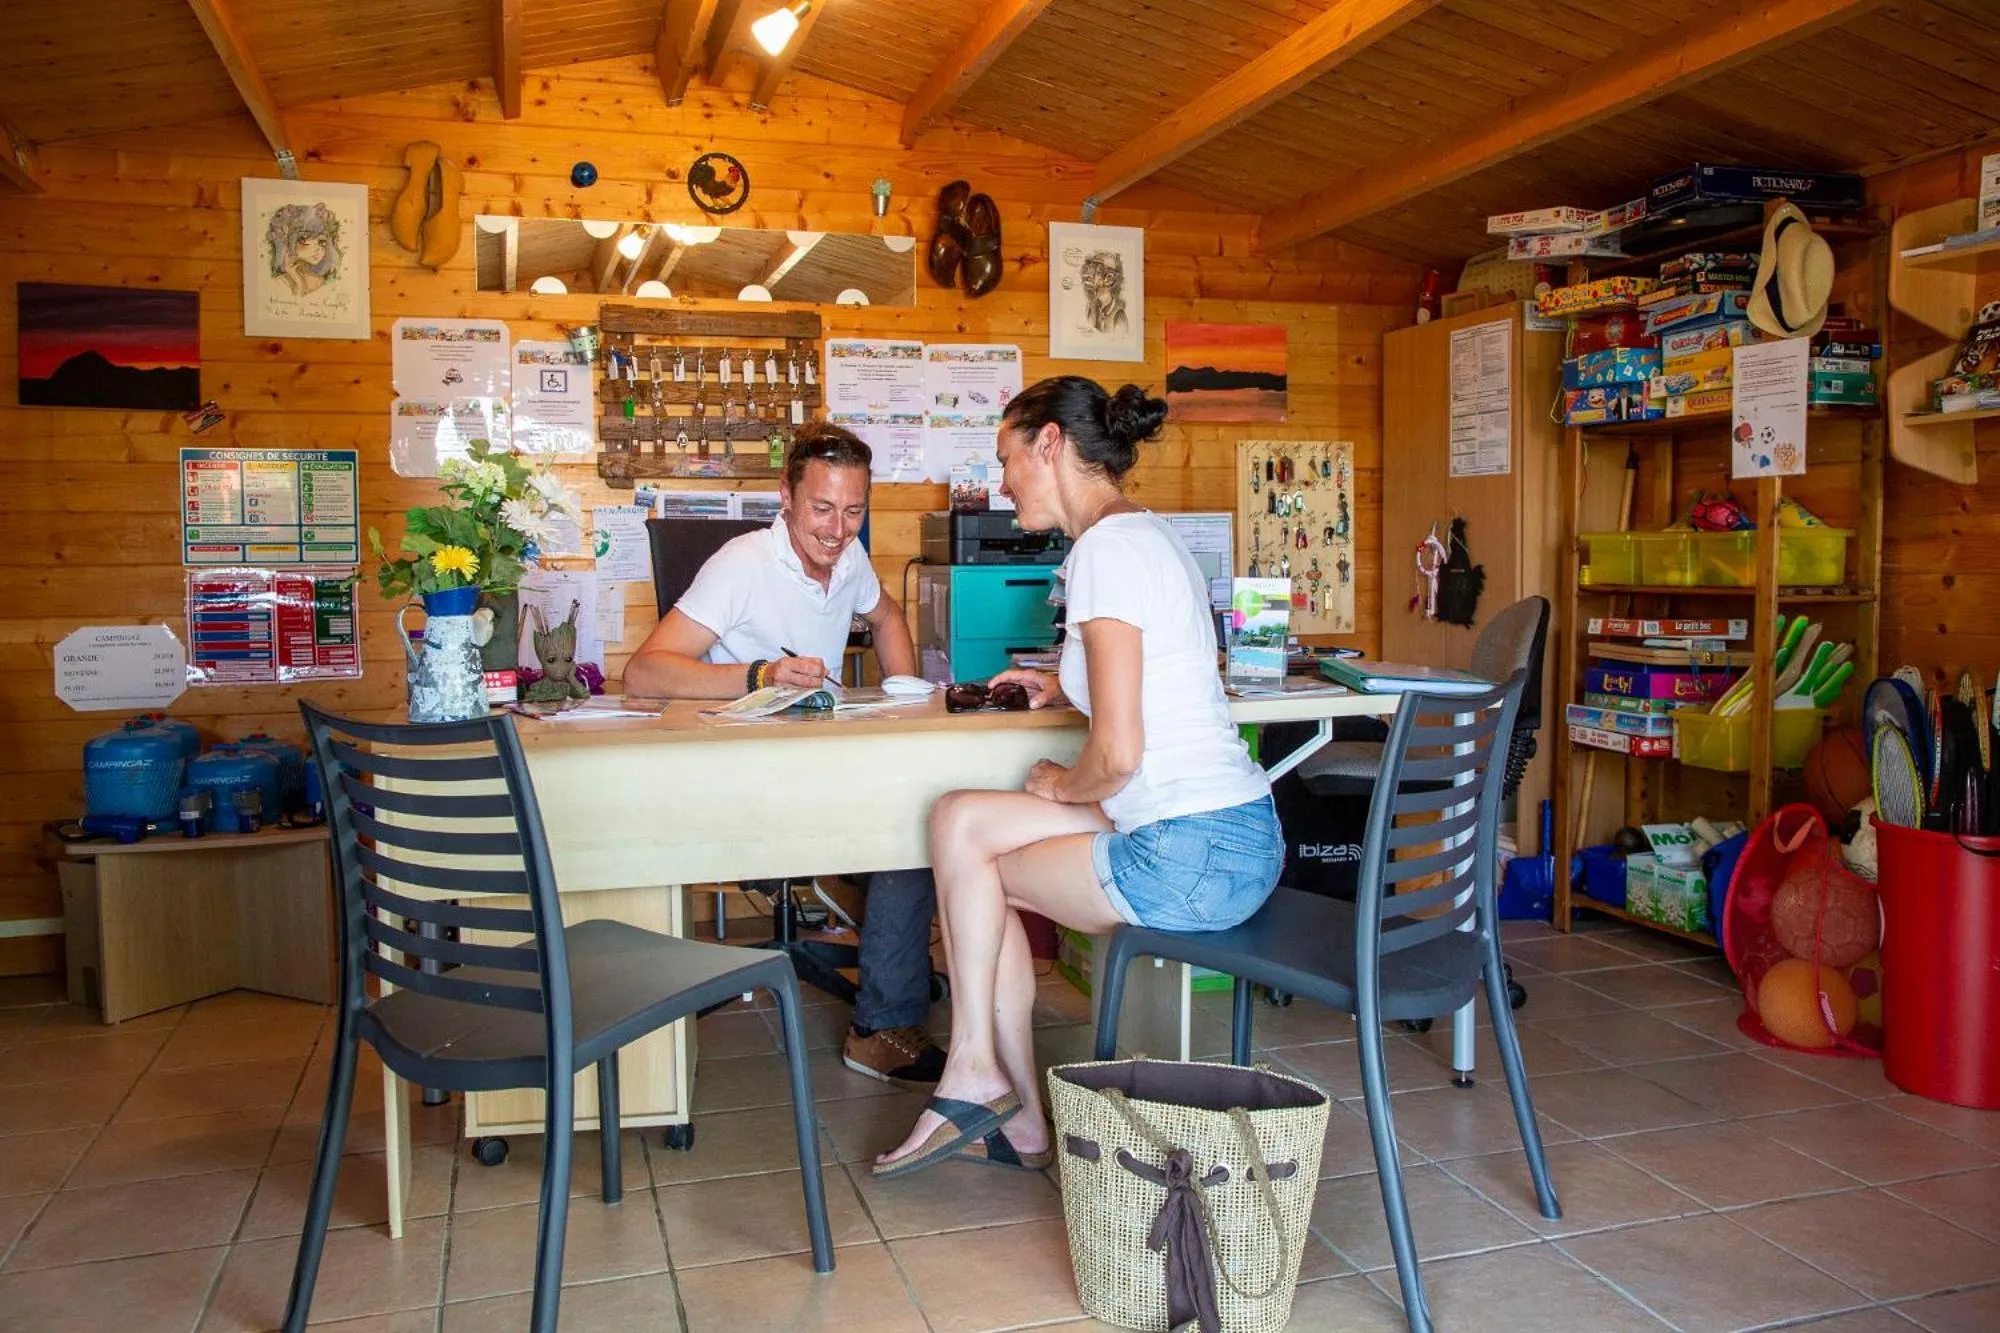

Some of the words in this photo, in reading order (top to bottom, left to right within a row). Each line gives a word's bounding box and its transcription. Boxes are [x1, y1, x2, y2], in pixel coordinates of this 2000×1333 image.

[1752, 176, 1809, 191] PICTIONARY
[208, 452, 265, 461] CONSIGNES
[266, 452, 282, 461] DE
[87, 758, 154, 769] CAMPINGAZ
[1299, 843, 1348, 858] ibiza
